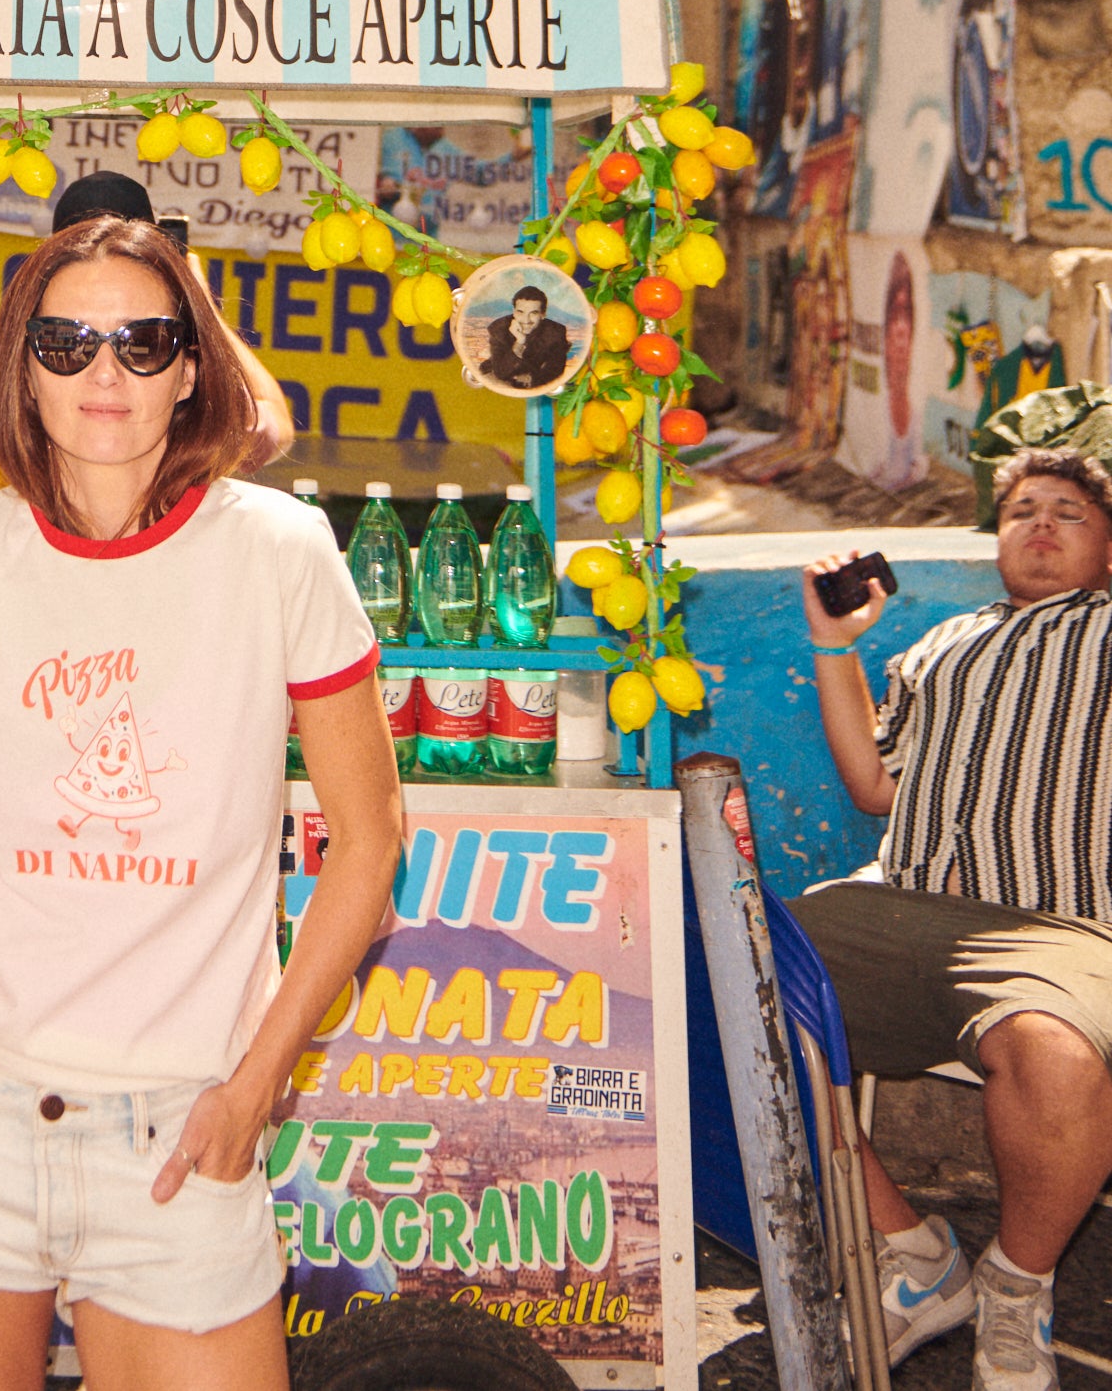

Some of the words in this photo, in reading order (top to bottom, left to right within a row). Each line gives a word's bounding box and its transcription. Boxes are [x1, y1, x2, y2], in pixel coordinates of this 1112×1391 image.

[139, 160, 220, 188] TUO
[197, 198, 315, 239] Diego
[21, 648, 139, 720] Pizza
[436, 682, 483, 711] Lete
[15, 849, 54, 876] DI
[68, 851, 199, 887] NAPOLI
[338, 1052, 550, 1100] APERTE
[576, 1067, 624, 1089] BIRRA
[629, 1071, 641, 1091] E
[551, 1085, 643, 1111] GRADINATA
